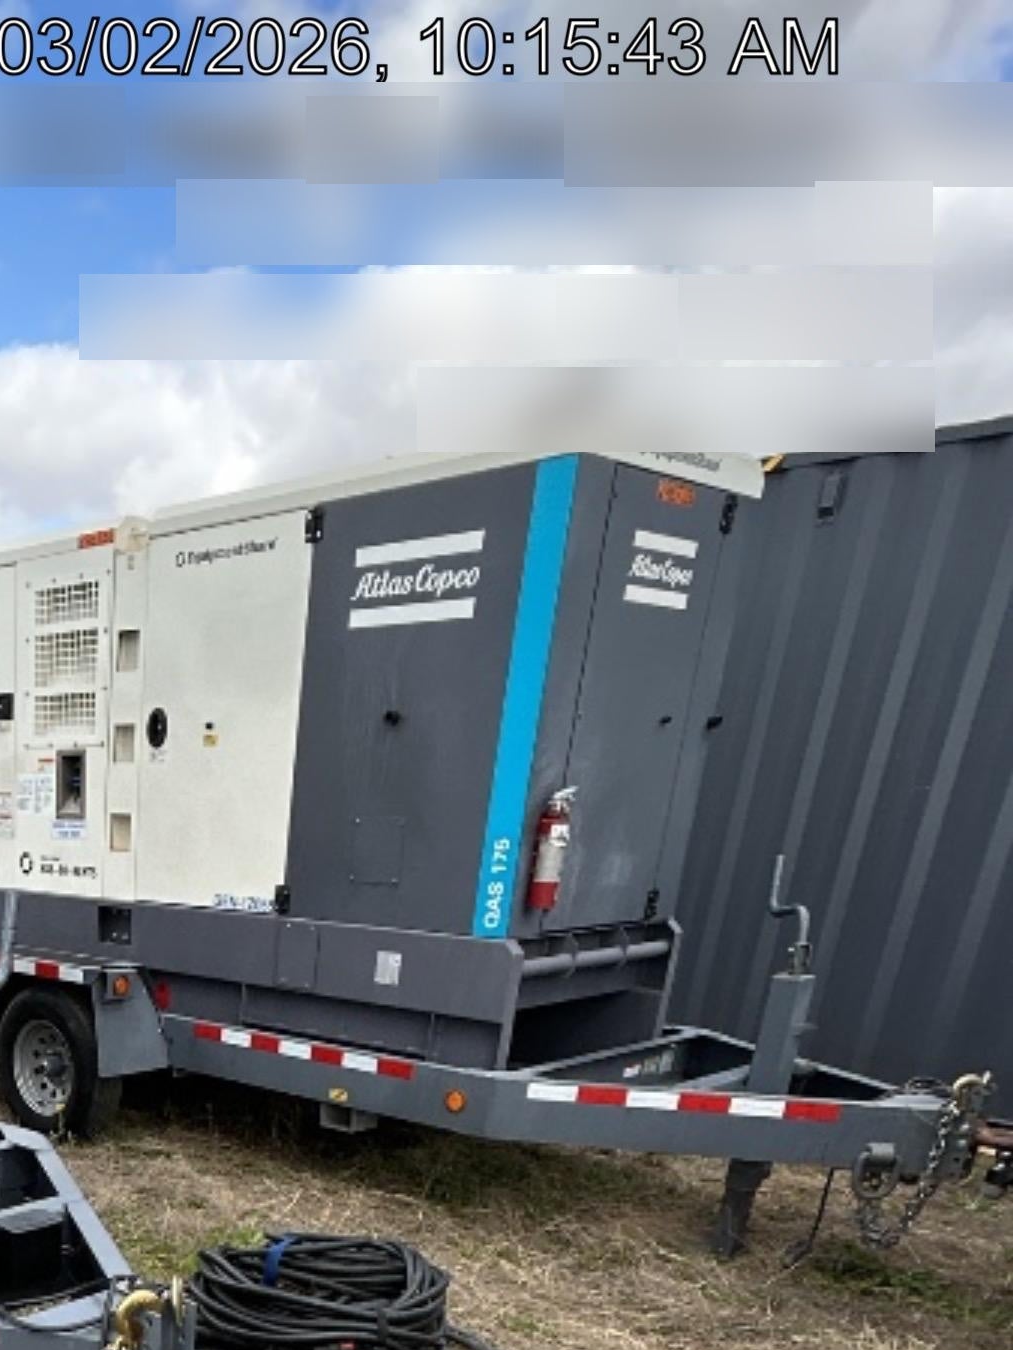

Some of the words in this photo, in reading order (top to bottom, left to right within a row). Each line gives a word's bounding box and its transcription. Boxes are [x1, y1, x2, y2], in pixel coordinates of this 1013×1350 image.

[349, 569, 414, 600] Atlas
[415, 563, 480, 597] Copco
[490, 837, 510, 874] 175
[484, 881, 505, 929] QAS
